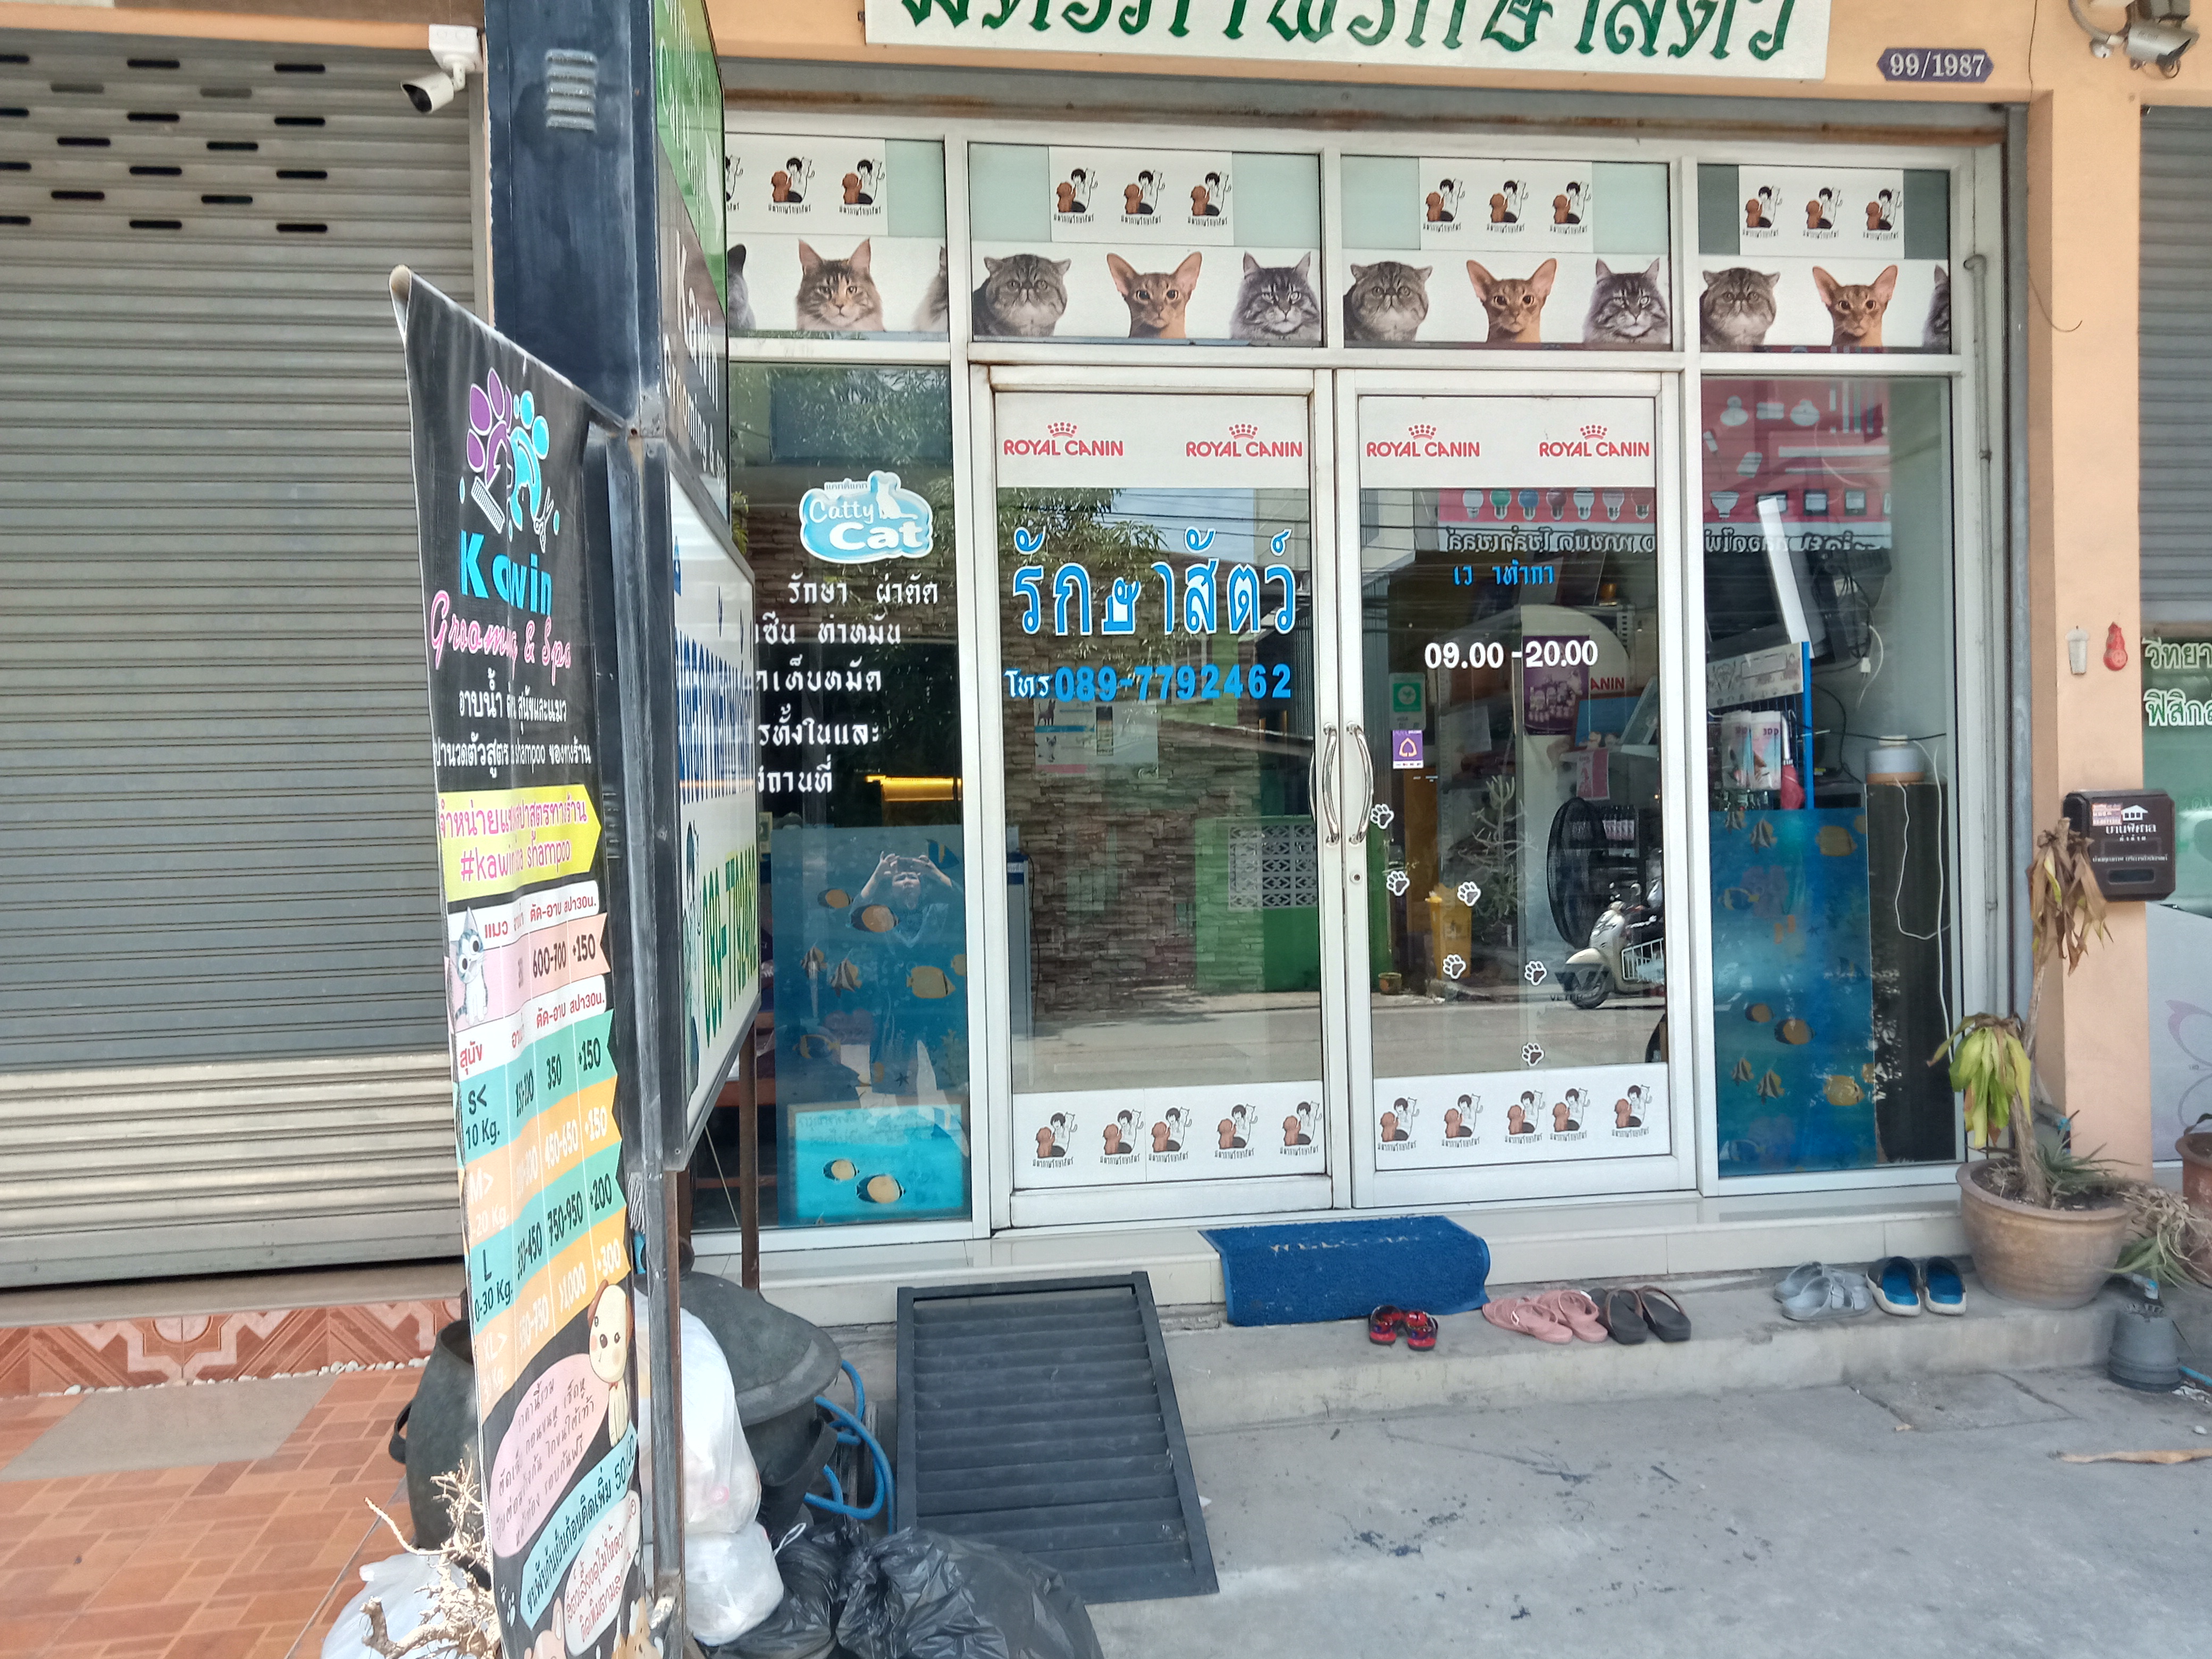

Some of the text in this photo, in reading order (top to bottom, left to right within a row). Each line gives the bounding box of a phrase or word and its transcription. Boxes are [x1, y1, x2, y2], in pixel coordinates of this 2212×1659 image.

[1888, 51, 1986, 79] 99/1987
[676, 229, 718, 412] Kawin
[664, 333, 707, 472] Grooming
[1003, 439, 1124, 456] ROYAL CANIN
[1186, 441, 1303, 457] ROYAL CANIN
[1367, 441, 1480, 457] ROYAL CANIN
[1539, 441, 1649, 457] ROYAL CANIN
[809, 499, 874, 525] Catty
[829, 521, 923, 550] Cat
[787, 571, 938, 605] รักษา ผ่าตัด
[1013, 526, 1295, 635] รักษาสัตว์
[542, 615, 571, 686] Spa
[1425, 642, 1504, 669] 09.00
[1525, 640, 1598, 668] 20.00
[459, 667, 502, 718] อาบน้ำ
[1003, 664, 1292, 701] โทร 089-7792462
[1590, 677, 1625, 691] ANIN
[527, 839, 571, 872] shampoo
[484, 919, 508, 938] แมว
[532, 941, 566, 978] 600-700
[703, 845, 757, 1049] 089-7792462
[547, 1053, 562, 1090] 350
[466, 1118, 500, 1149] 10 Kg.
